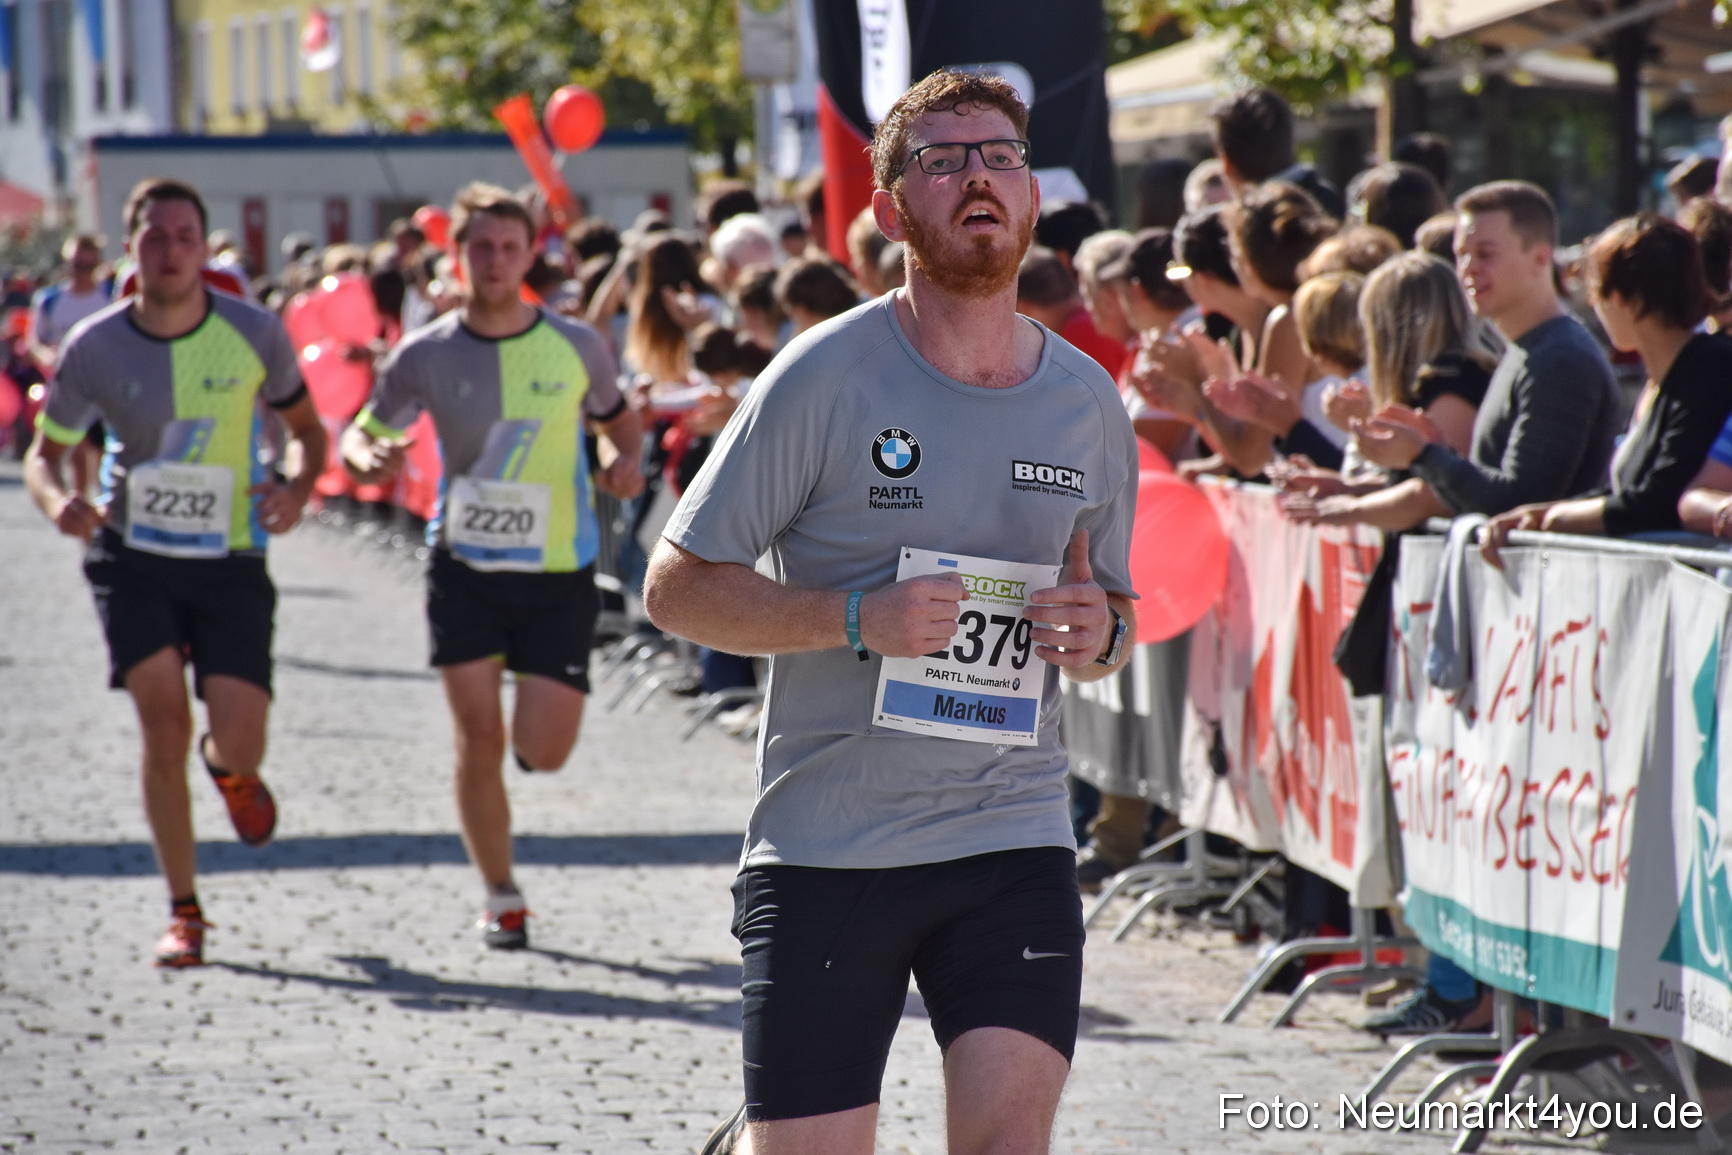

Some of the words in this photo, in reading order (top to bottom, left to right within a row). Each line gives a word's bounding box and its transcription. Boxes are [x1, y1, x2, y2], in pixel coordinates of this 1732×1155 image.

[876, 429, 917, 447] BMW
[1012, 460, 1084, 494] BOCK
[1012, 483, 1041, 492] inspired
[1042, 486, 1050, 494] by
[1051, 488, 1069, 496] smart
[144, 486, 217, 520] 2232
[869, 486, 923, 499] PARTL
[869, 499, 923, 509] Neumarkt
[463, 503, 535, 535] 2220
[960, 573, 1026, 600] BOCK
[921, 610, 1033, 670] 379
[925, 667, 964, 683] PARTL
[966, 673, 1011, 690] Neumarkt
[933, 693, 1007, 725] Markus
